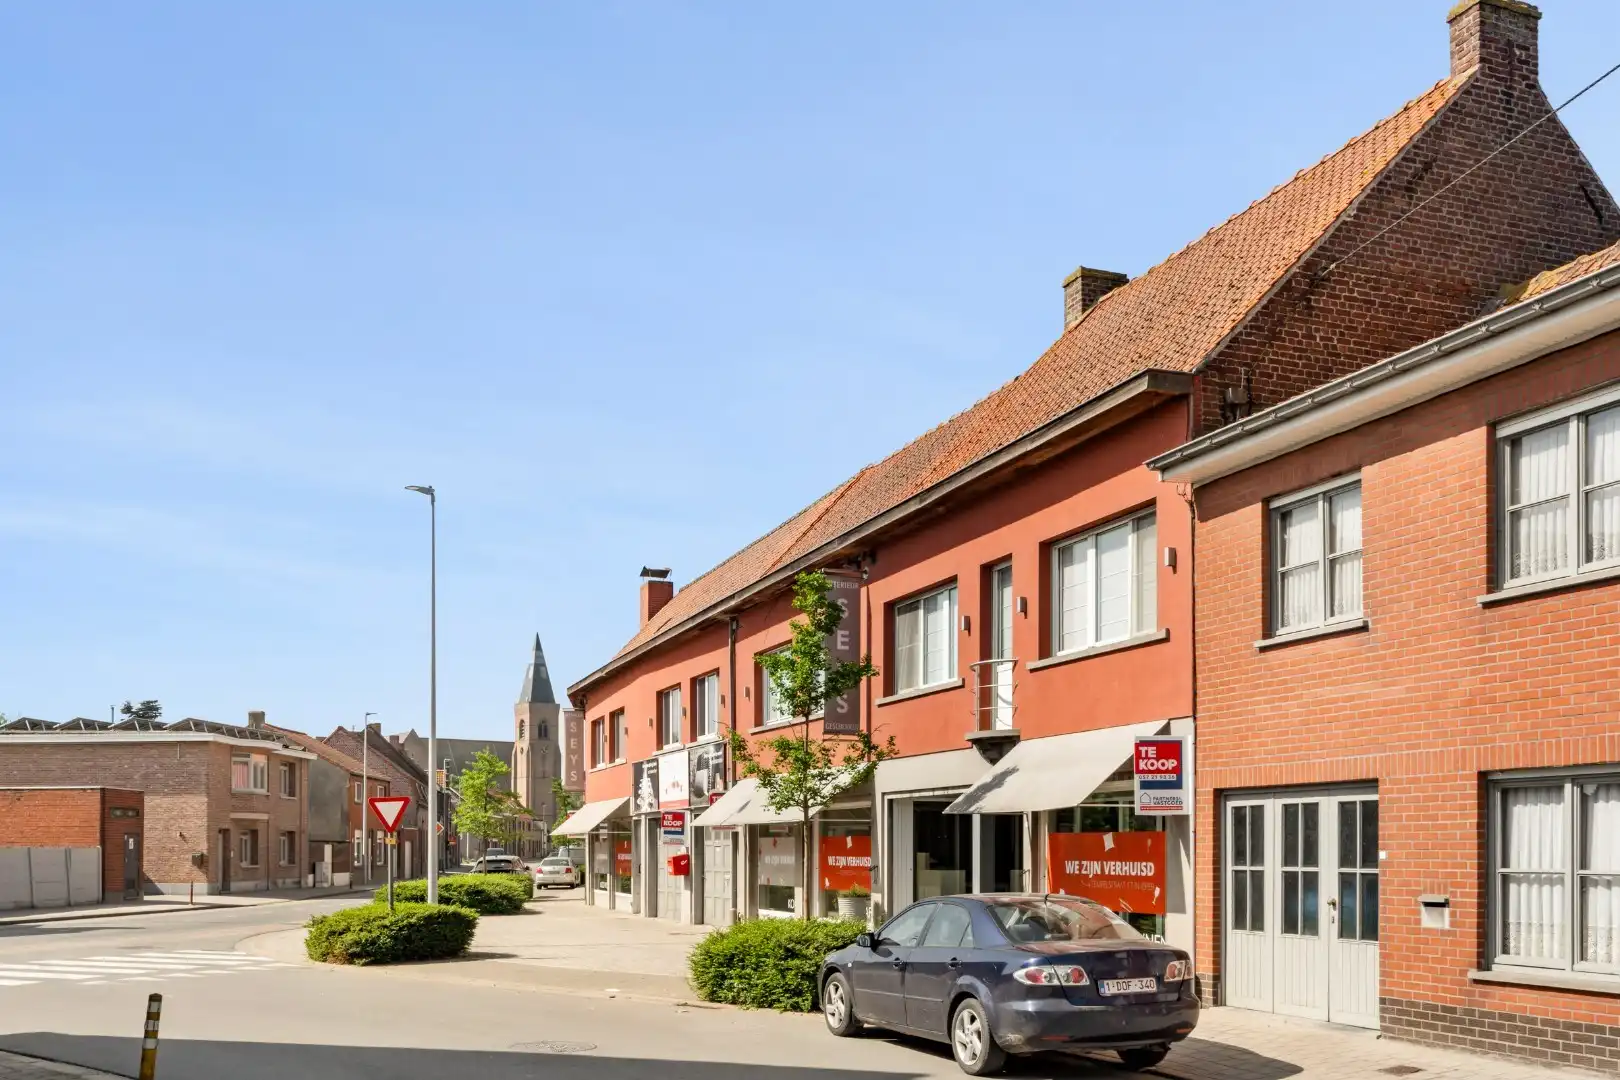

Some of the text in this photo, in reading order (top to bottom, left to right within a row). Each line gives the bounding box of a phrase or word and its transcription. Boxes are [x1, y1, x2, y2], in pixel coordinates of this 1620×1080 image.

[836, 598, 851, 714] SES
[570, 721, 578, 782] SEYS
[1138, 746, 1157, 758] TE
[1138, 759, 1178, 771] KOOP
[828, 855, 835, 866] WE
[836, 855, 847, 868] ZIJN
[1065, 860, 1155, 878] WE ZIJN VERHUISD
